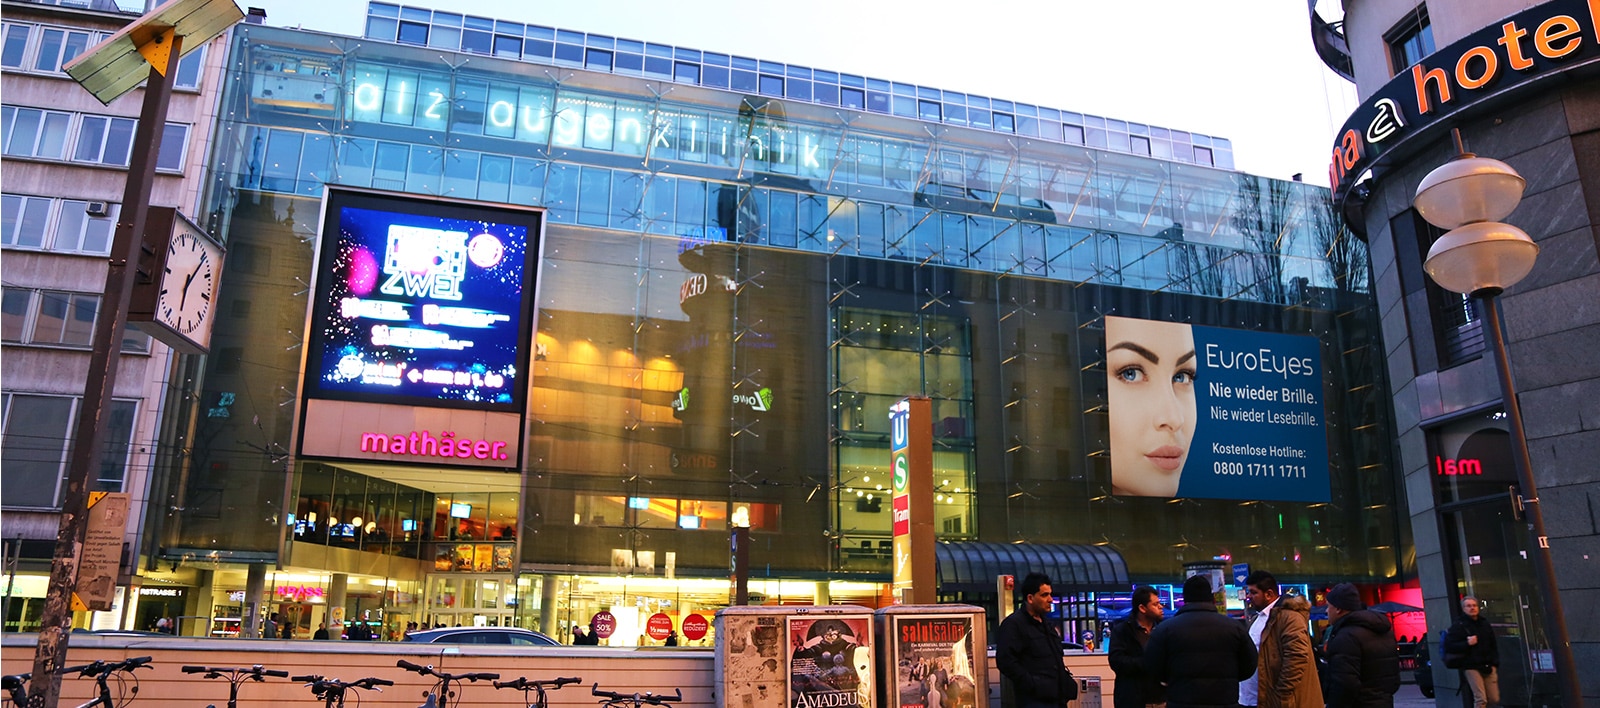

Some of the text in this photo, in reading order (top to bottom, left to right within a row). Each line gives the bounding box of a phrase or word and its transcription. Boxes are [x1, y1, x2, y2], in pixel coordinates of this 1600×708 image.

[354, 81, 444, 119] alz
[382, 270, 462, 300] ZWEI
[1205, 343, 1314, 380] EuroEyes
[1209, 382, 1318, 405] Nie wieder Brille.
[1210, 405, 1319, 426] Nie wieder Lesebrille.
[895, 416, 905, 446] U
[361, 430, 508, 460] mathäser.
[1212, 442, 1307, 459] Kostenlose Hotline:
[895, 456, 906, 489] S
[1213, 461, 1306, 479] 0800 1711 1711
[894, 509, 909, 523] Tram
[277, 584, 323, 600] KRASS
[596, 624, 611, 632] 50%
[795, 688, 869, 708] AMADEUS
